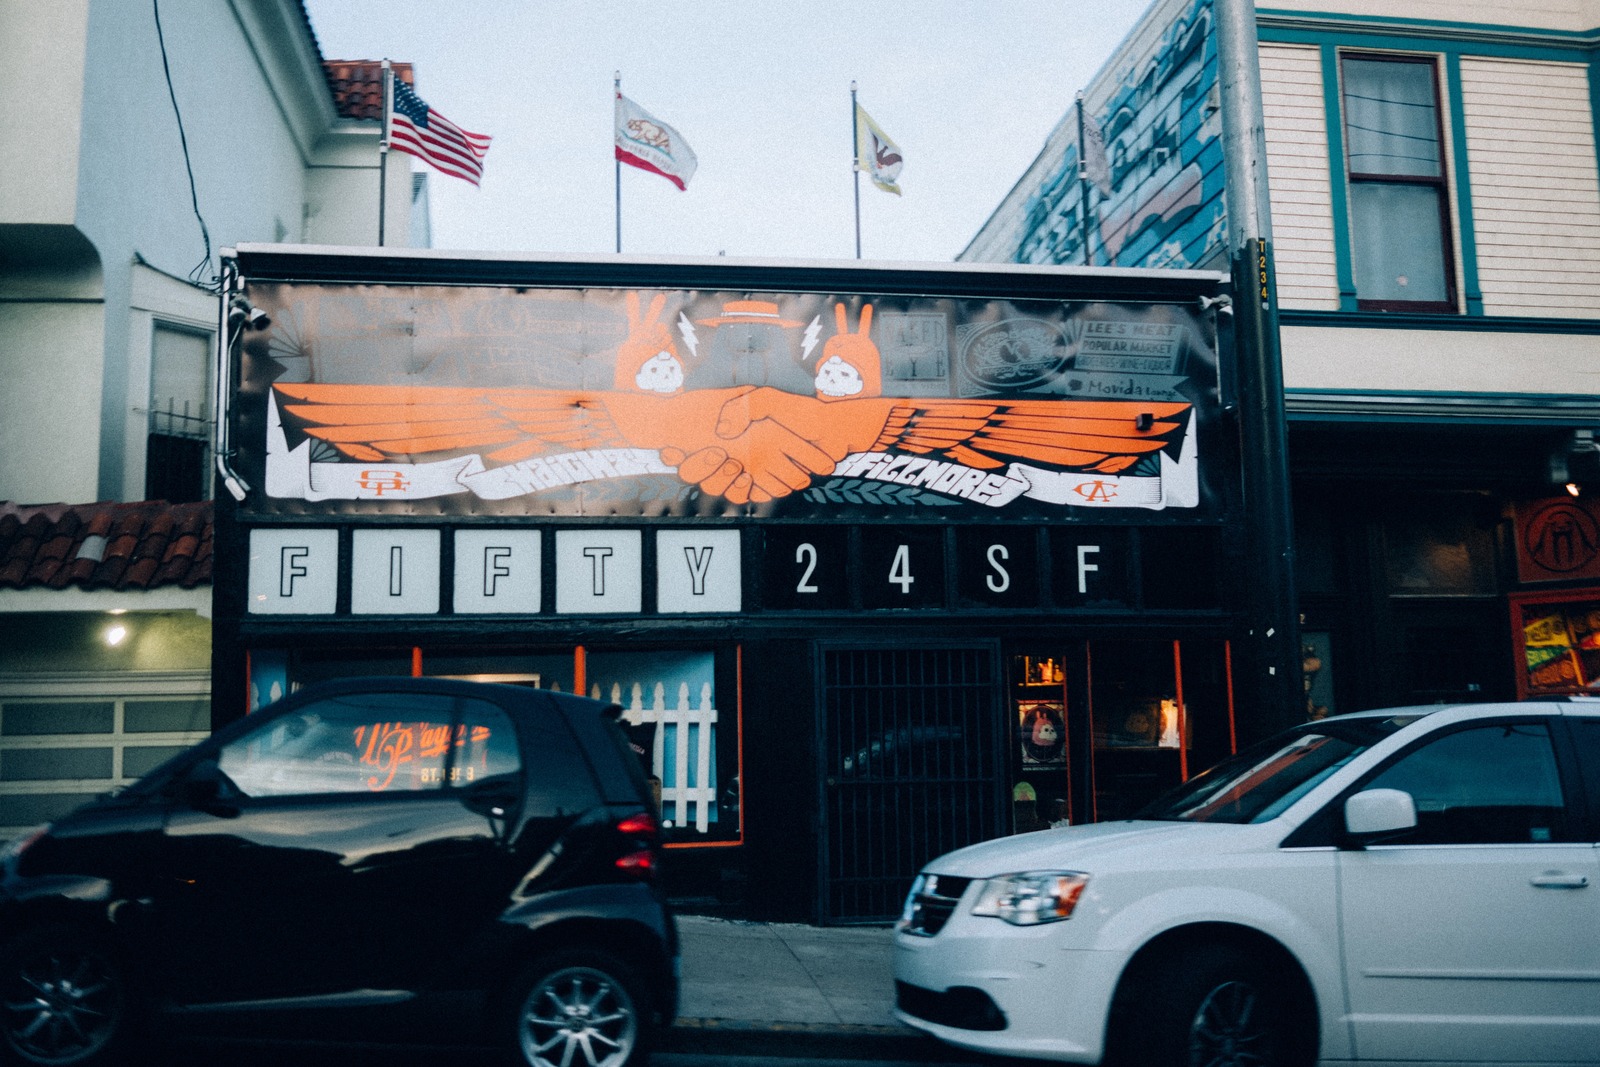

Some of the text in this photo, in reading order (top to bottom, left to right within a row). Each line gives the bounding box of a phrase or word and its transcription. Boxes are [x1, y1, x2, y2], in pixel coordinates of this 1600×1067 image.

[1133, 324, 1177, 337] MEAT
[1083, 339, 1173, 355] POPULAR MARKET
[1087, 378, 1143, 396] Movida
[280, 545, 714, 598] FIFTY
